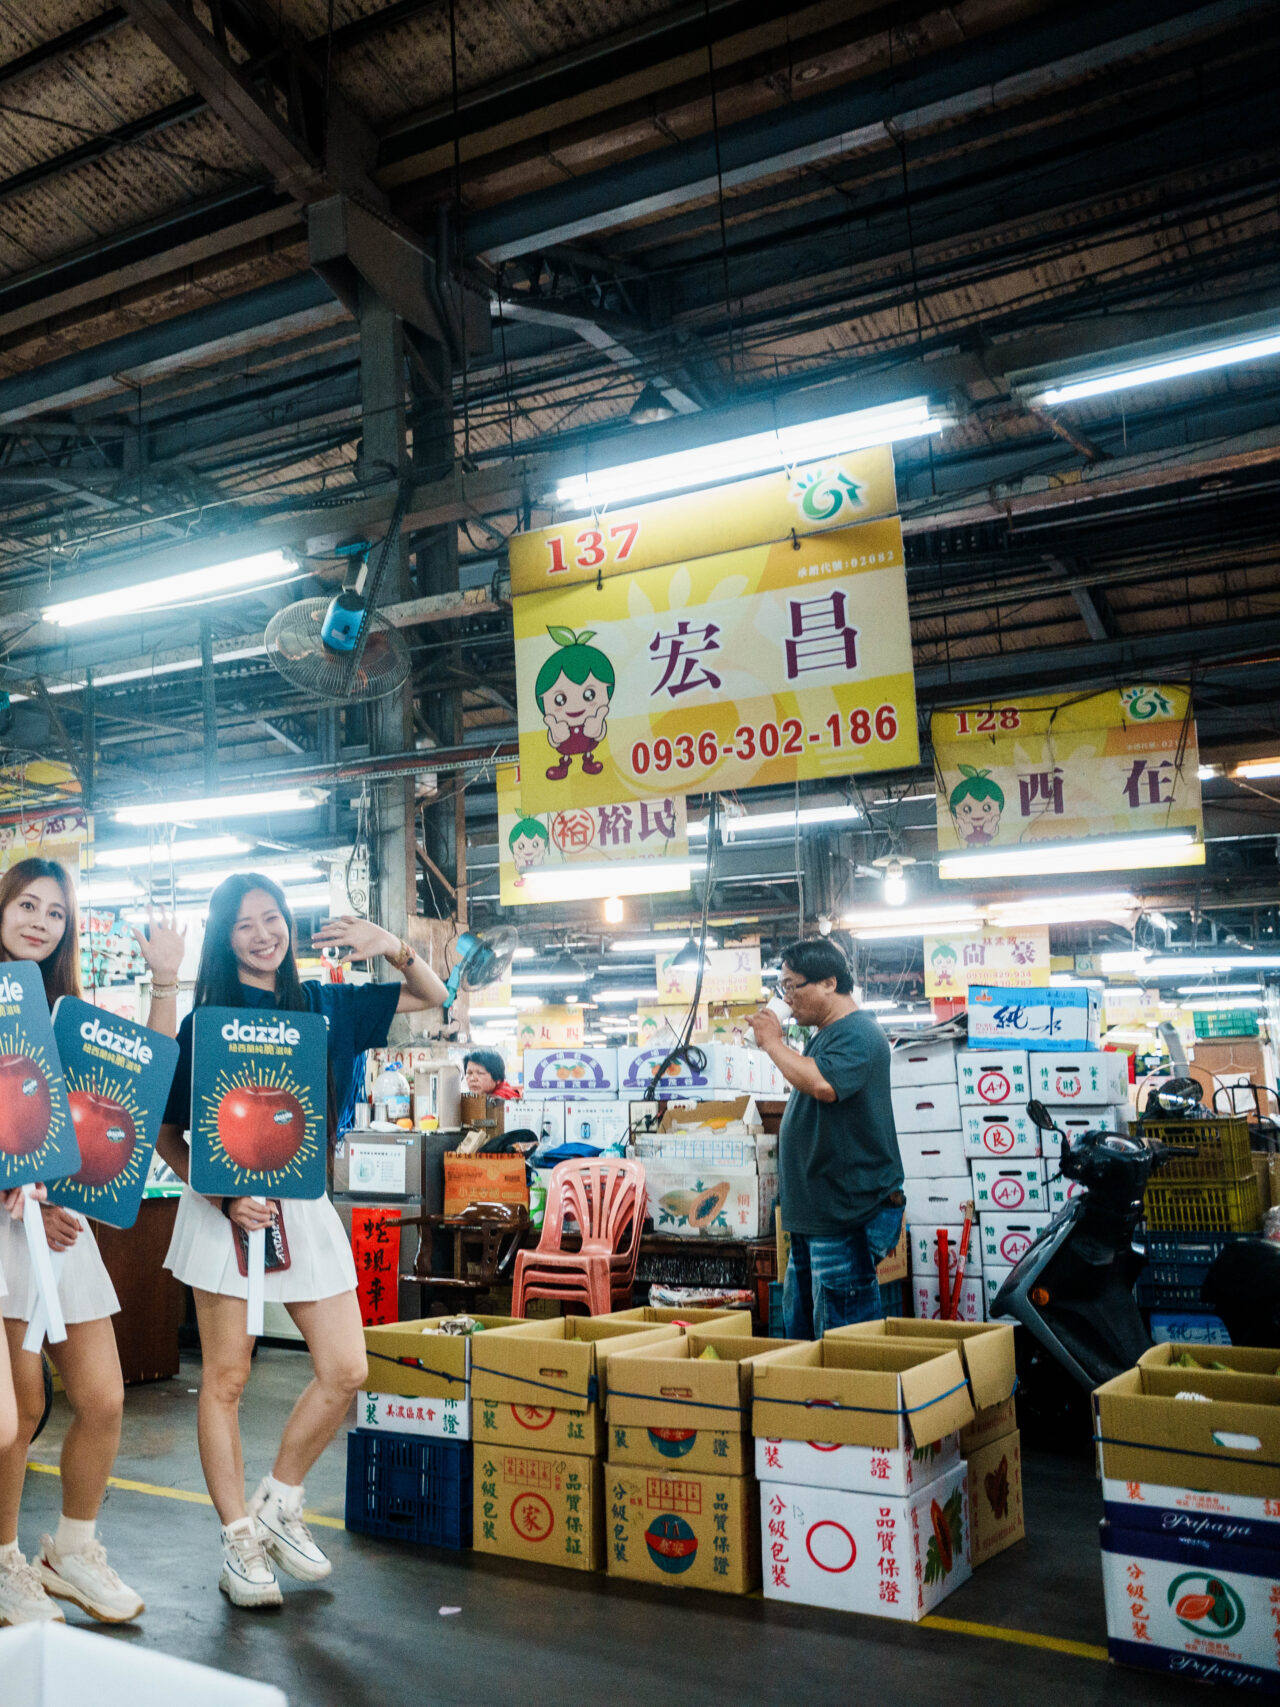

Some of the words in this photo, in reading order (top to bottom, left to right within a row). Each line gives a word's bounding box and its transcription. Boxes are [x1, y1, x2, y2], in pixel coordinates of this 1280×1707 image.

[547, 522, 639, 574] 137
[649, 590, 858, 698] 宏昌
[631, 705, 898, 775] 0936-302-186
[956, 707, 1020, 734] 128
[557, 814, 590, 848] 裕
[597, 799, 675, 846] 裕民
[80, 1019, 153, 1064] dazzle
[221, 1019, 300, 1045] dazzle
[984, 1079, 1005, 1094] A+
[998, 1187, 1020, 1200] A+
[385, 1404, 436, 1421] 美濃區農會
[481, 1460, 499, 1541] 分級包裝
[522, 1504, 543, 1533] 家
[565, 1473, 584, 1555] 品質保証
[611, 1483, 629, 1562] 分級包裝
[1161, 1512, 1252, 1538] Papaya
[713, 1493, 730, 1576] 品質保證
[768, 1494, 791, 1589] 分級包裝
[876, 1507, 901, 1604] 品質保證
[1126, 1562, 1152, 1642] 分級包裝
[1169, 1654, 1264, 1686] Papaya
